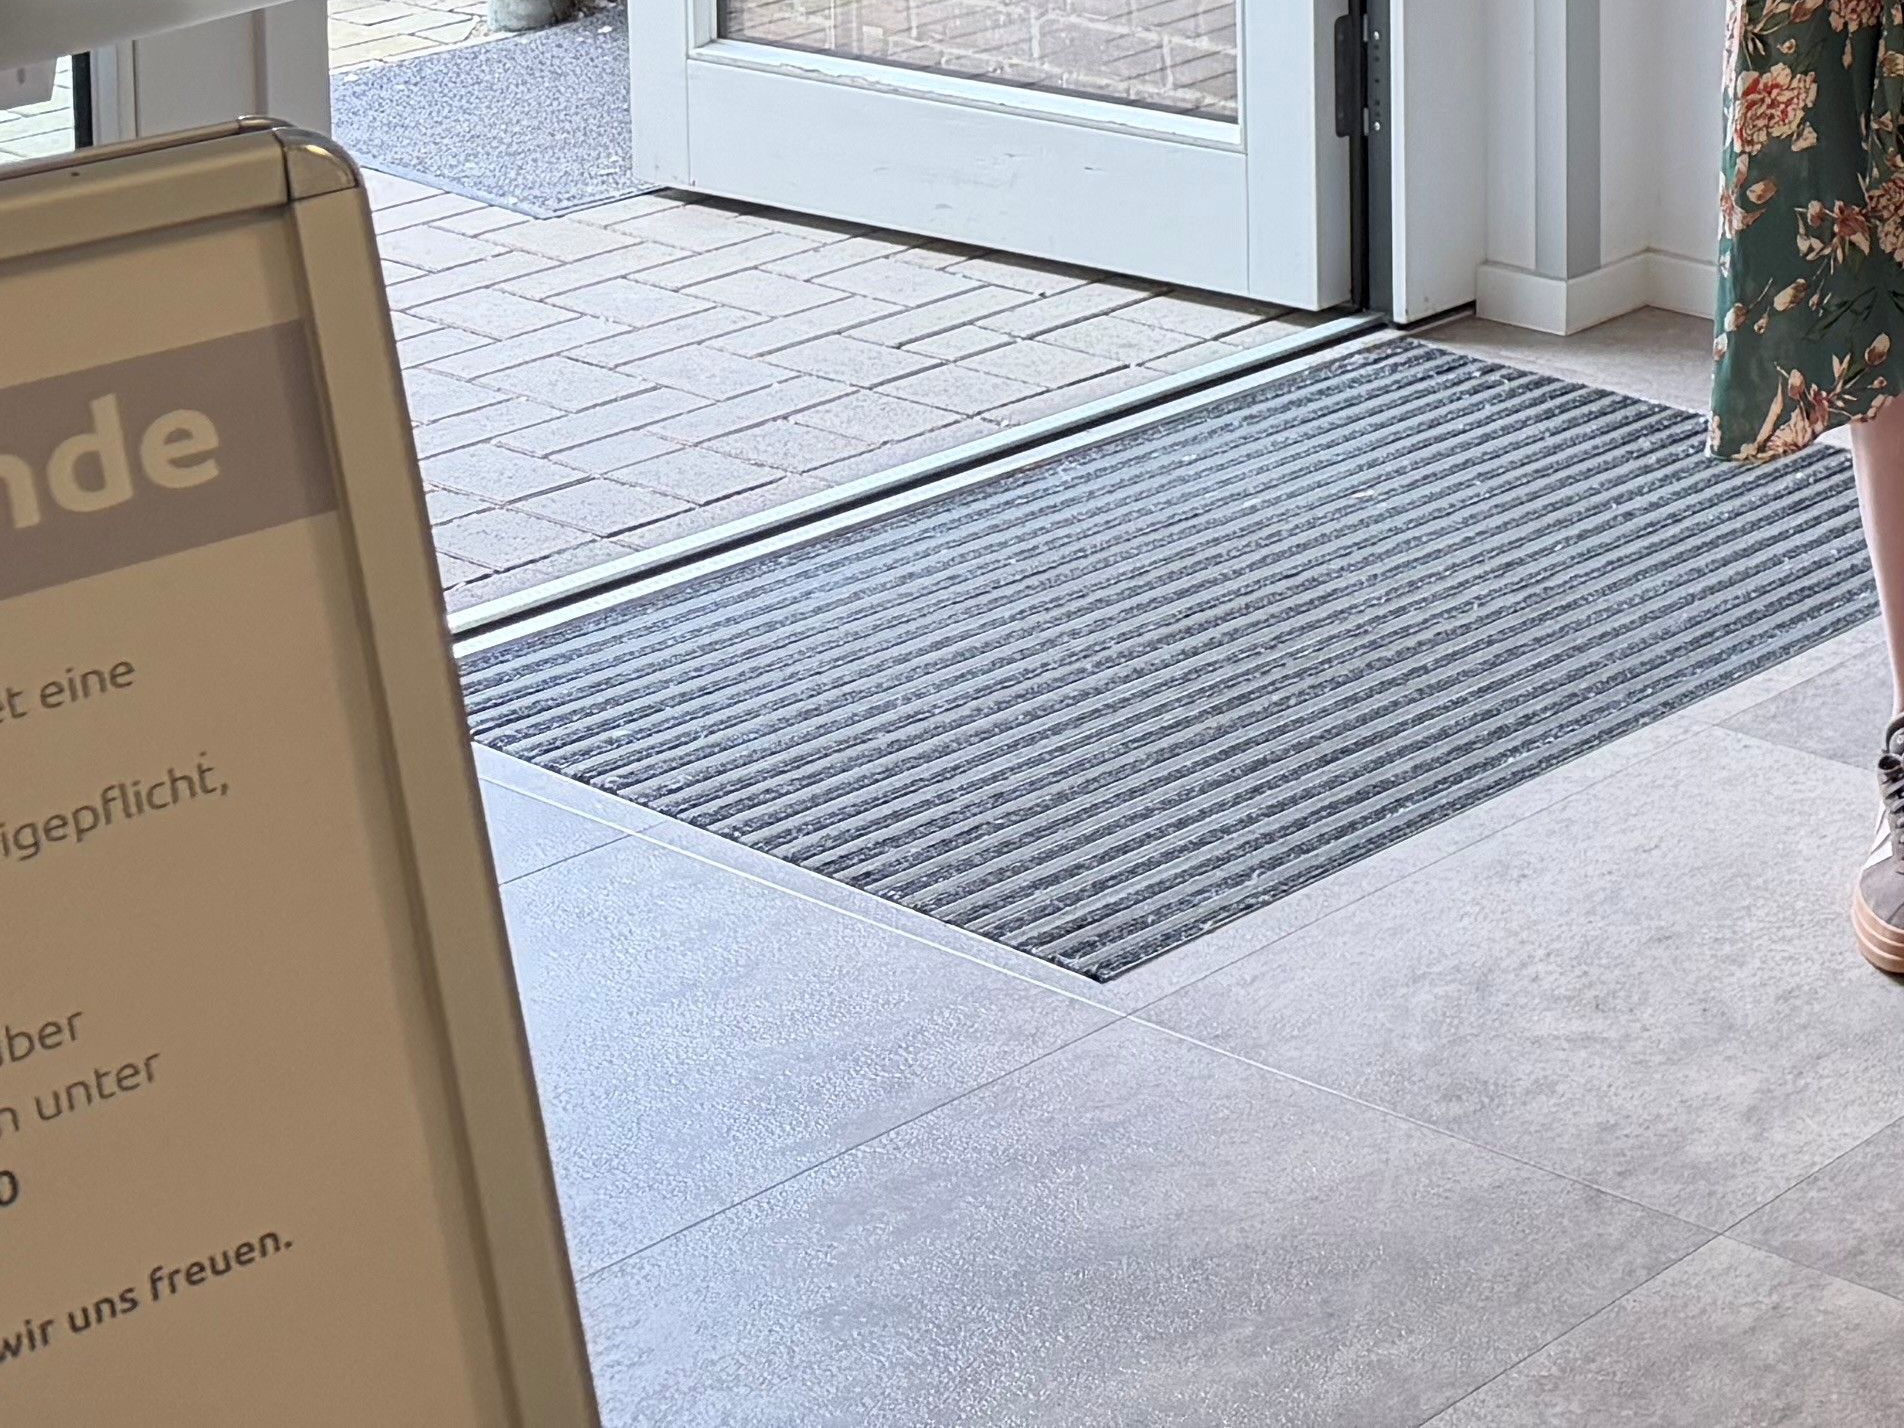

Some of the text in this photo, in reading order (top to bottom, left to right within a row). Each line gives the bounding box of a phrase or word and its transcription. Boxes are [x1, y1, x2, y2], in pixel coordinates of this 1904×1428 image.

[40, 660, 136, 710] eine
[0, 1010, 83, 1067] ber
[34, 1052, 161, 1121] unter
[67, 1286, 140, 1335] uns
[148, 1230, 294, 1303] freuen.
